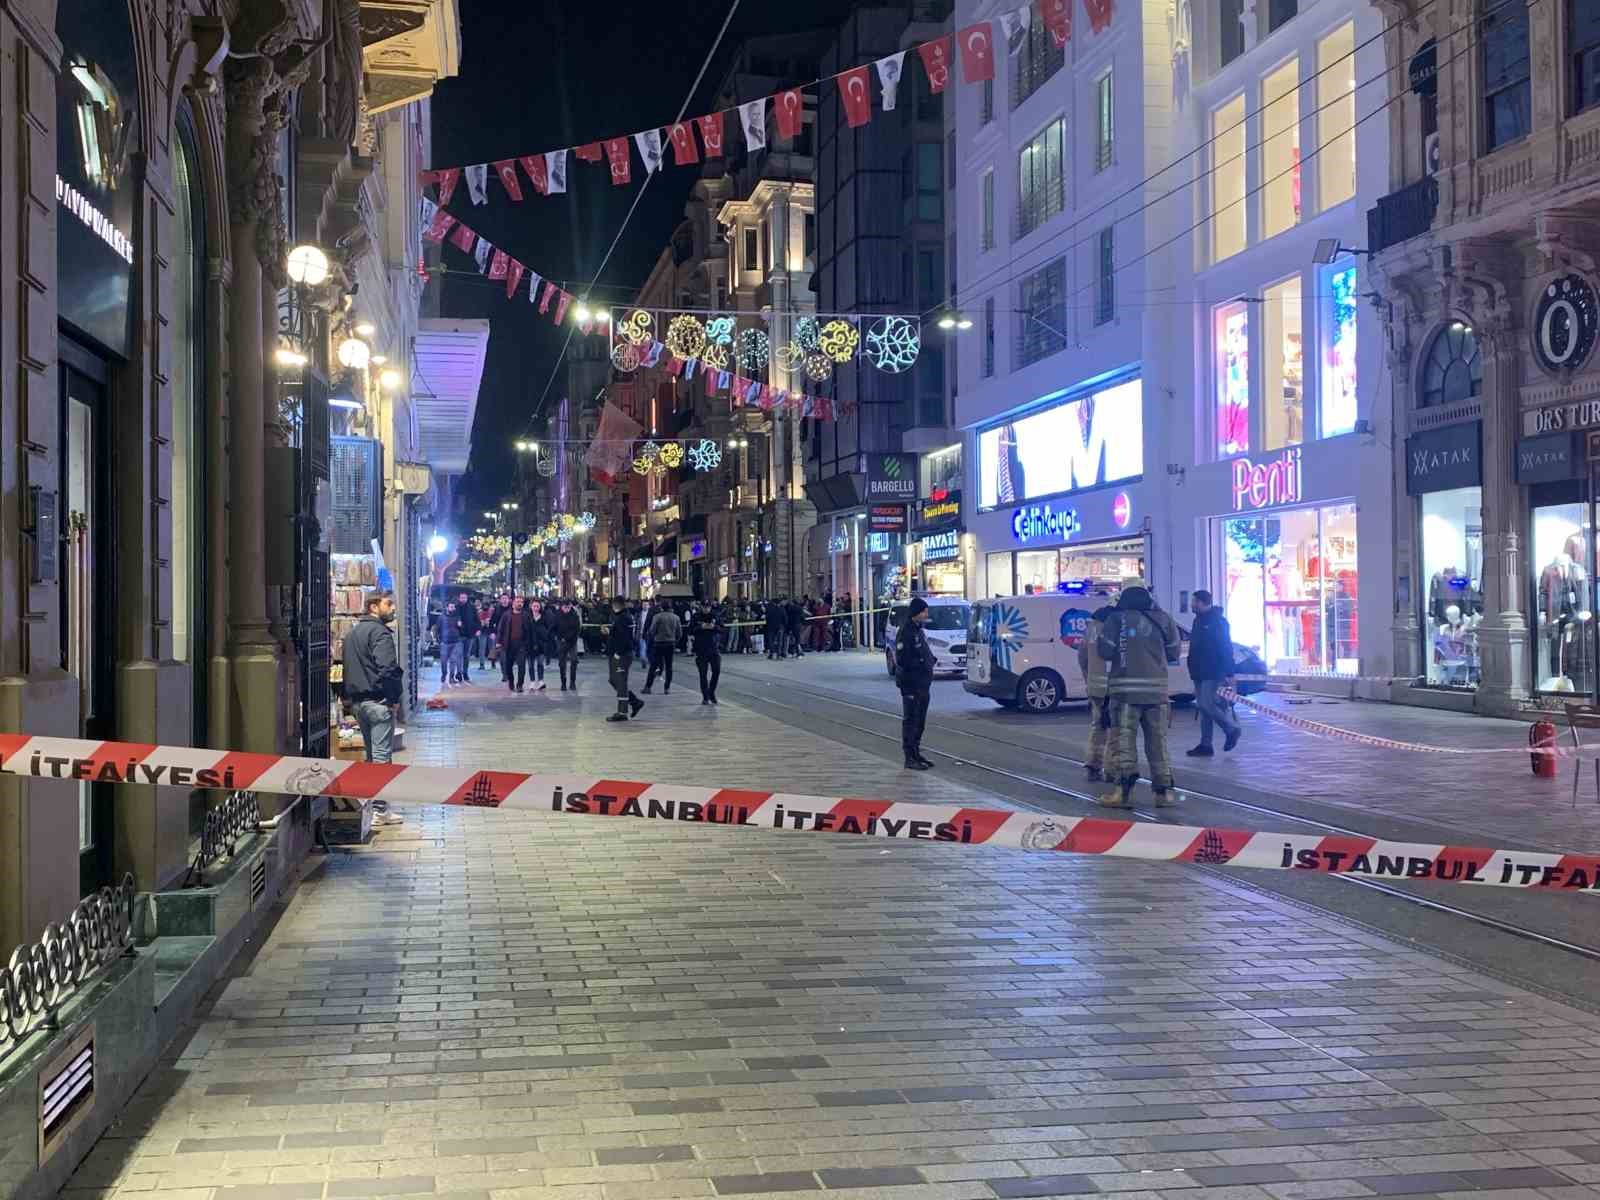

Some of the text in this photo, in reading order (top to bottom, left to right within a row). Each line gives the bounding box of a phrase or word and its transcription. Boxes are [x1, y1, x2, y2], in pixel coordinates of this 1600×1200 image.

[871, 480, 914, 493] BARGELLO
[1231, 448, 1303, 510] Penti
[31, 750, 235, 789] İTFAİYESİ
[552, 786, 972, 844] İSTANBUL İTFAİYESİ
[1281, 843, 1484, 883] İSTANBUL
